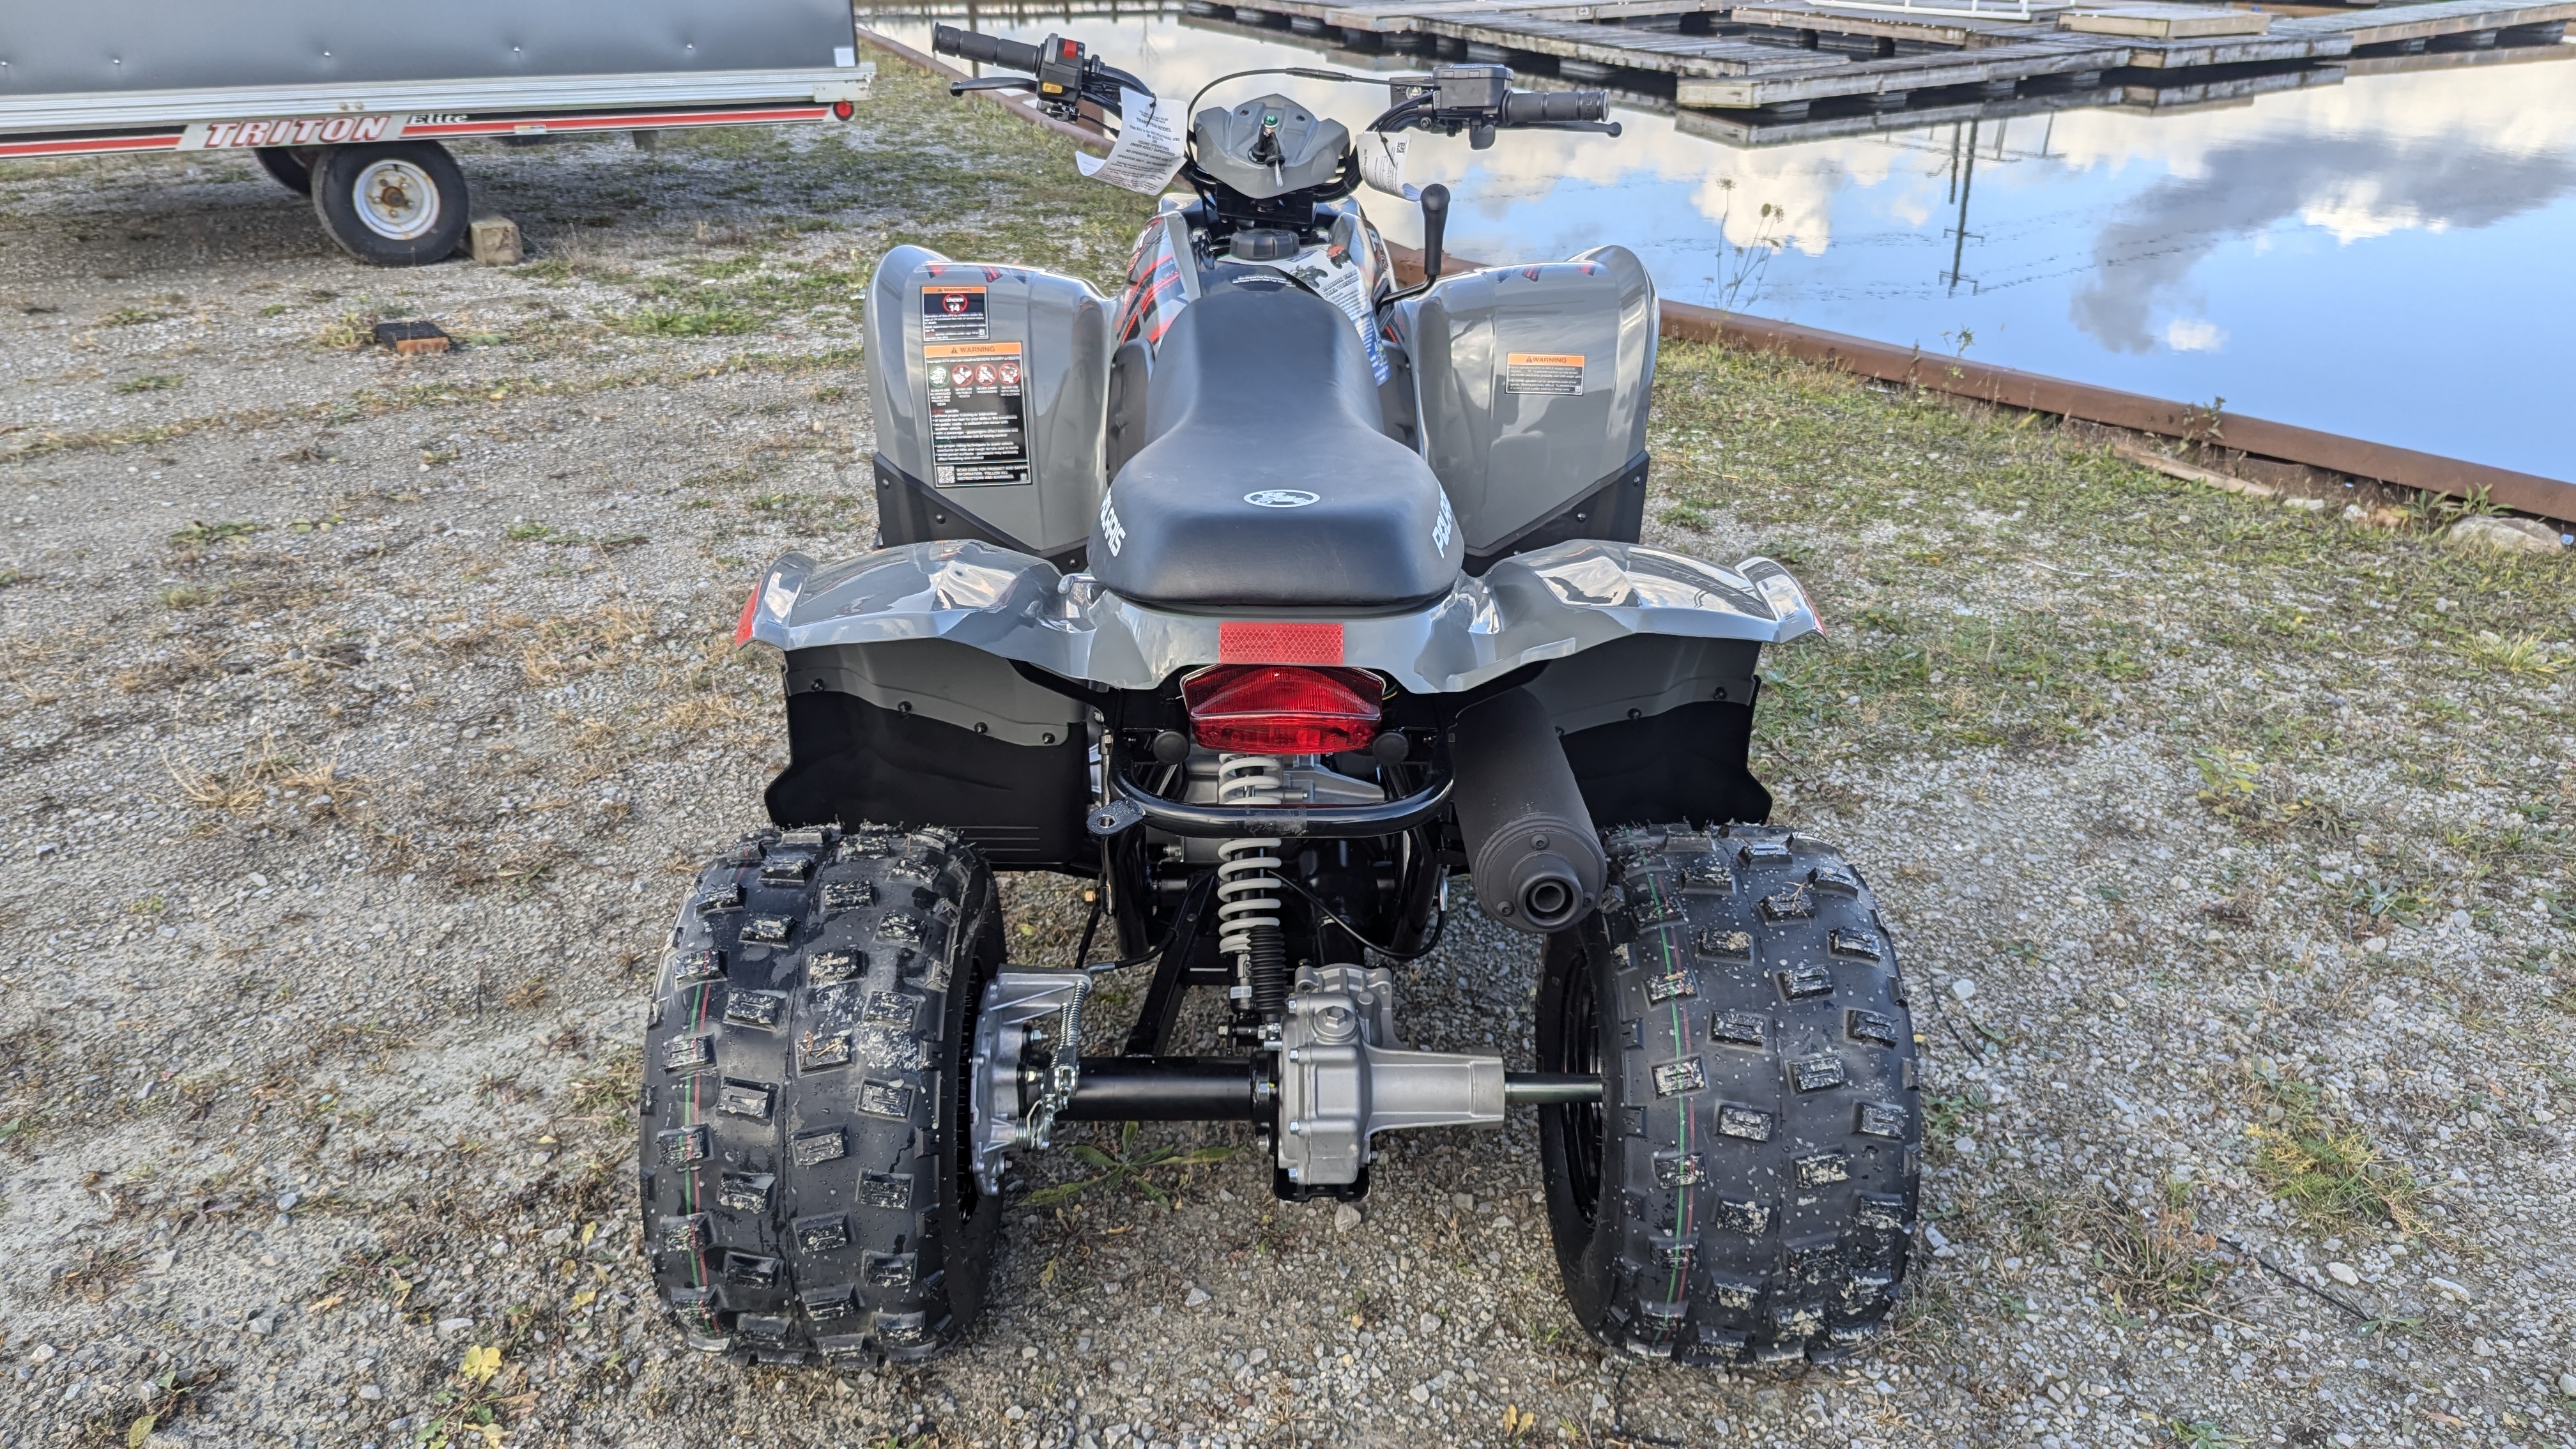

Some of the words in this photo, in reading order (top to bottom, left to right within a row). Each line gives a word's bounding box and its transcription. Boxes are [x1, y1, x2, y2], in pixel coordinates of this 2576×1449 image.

[204, 115, 391, 148] TRITON
[408, 113, 468, 125] Elite
[1432, 481, 1452, 559] POLAR
